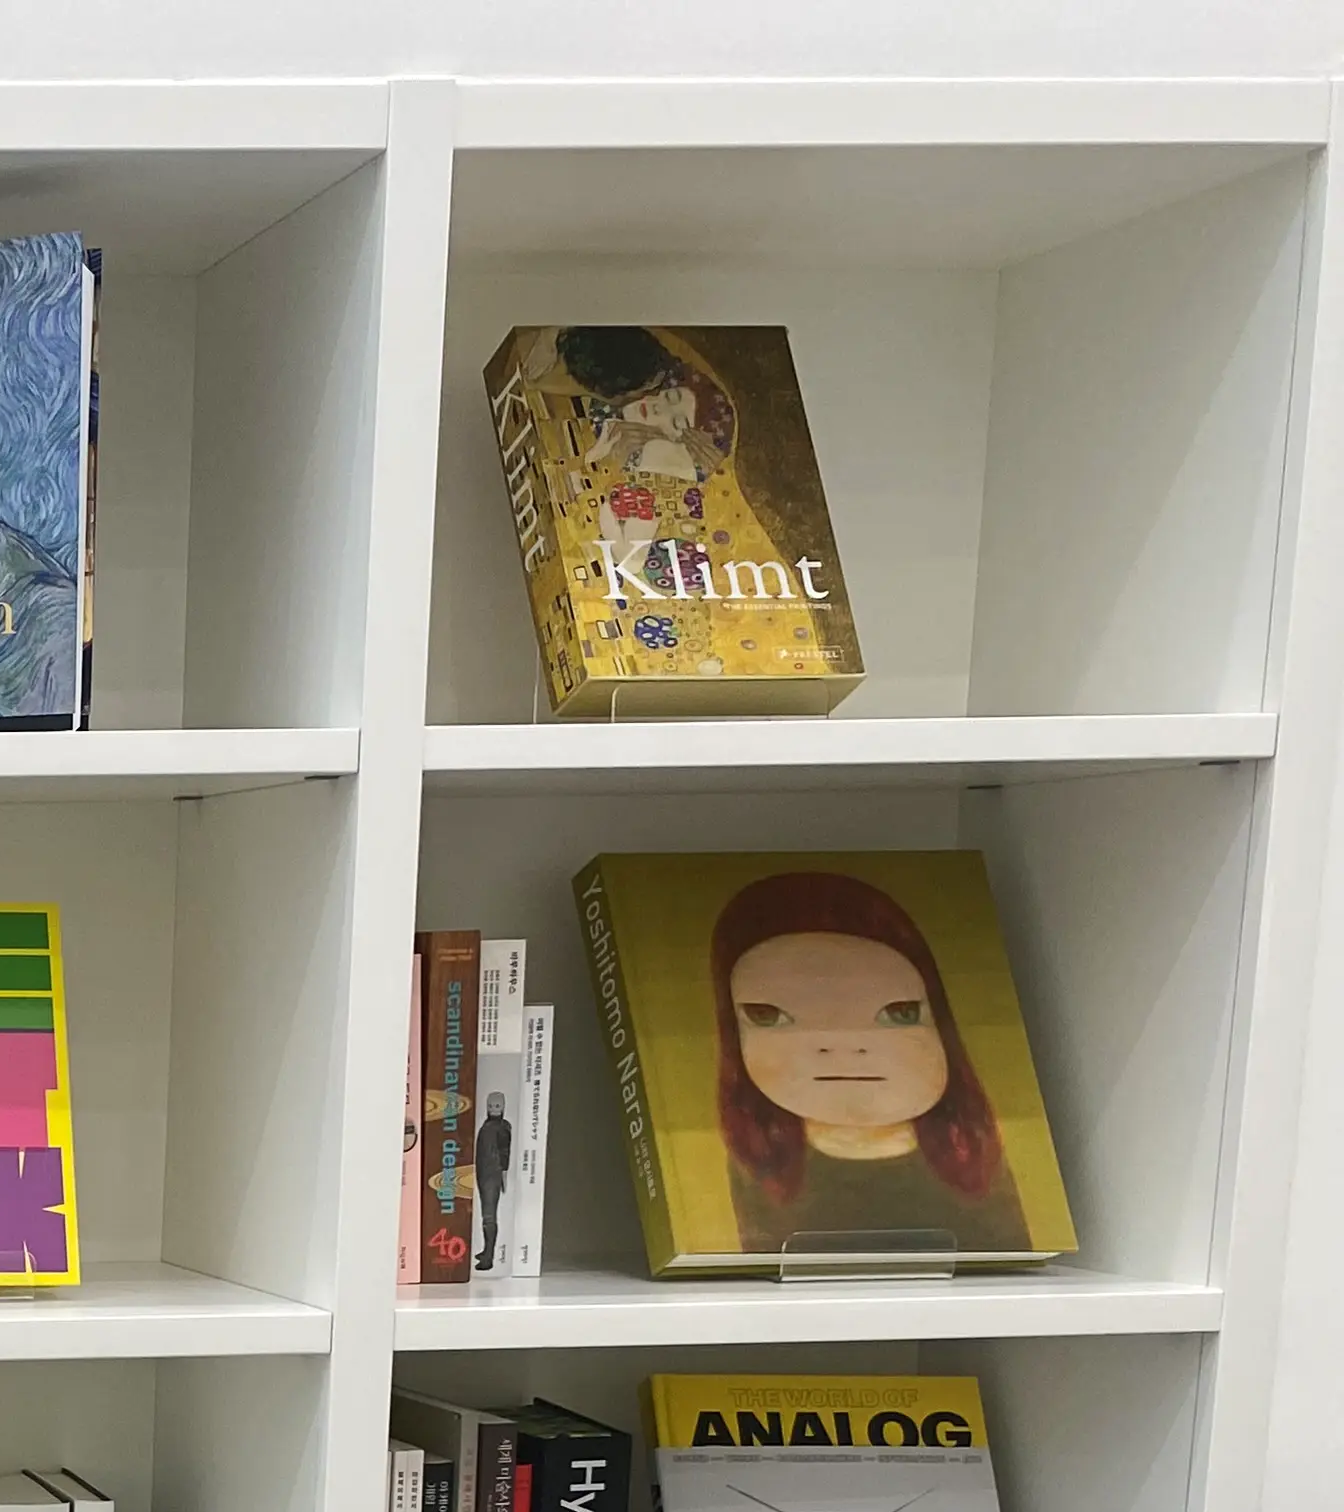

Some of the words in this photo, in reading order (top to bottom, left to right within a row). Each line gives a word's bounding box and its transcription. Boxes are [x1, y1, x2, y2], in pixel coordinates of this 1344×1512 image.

[492, 362, 546, 574] Klimt
[593, 539, 830, 600] Klimt
[441, 981, 462, 1131] scandinavian
[579, 872, 627, 1050] Yoshitomo
[616, 1053, 644, 1141] Nara
[433, 1136, 456, 1215] design
[692, 1411, 973, 1447] ANALOG
